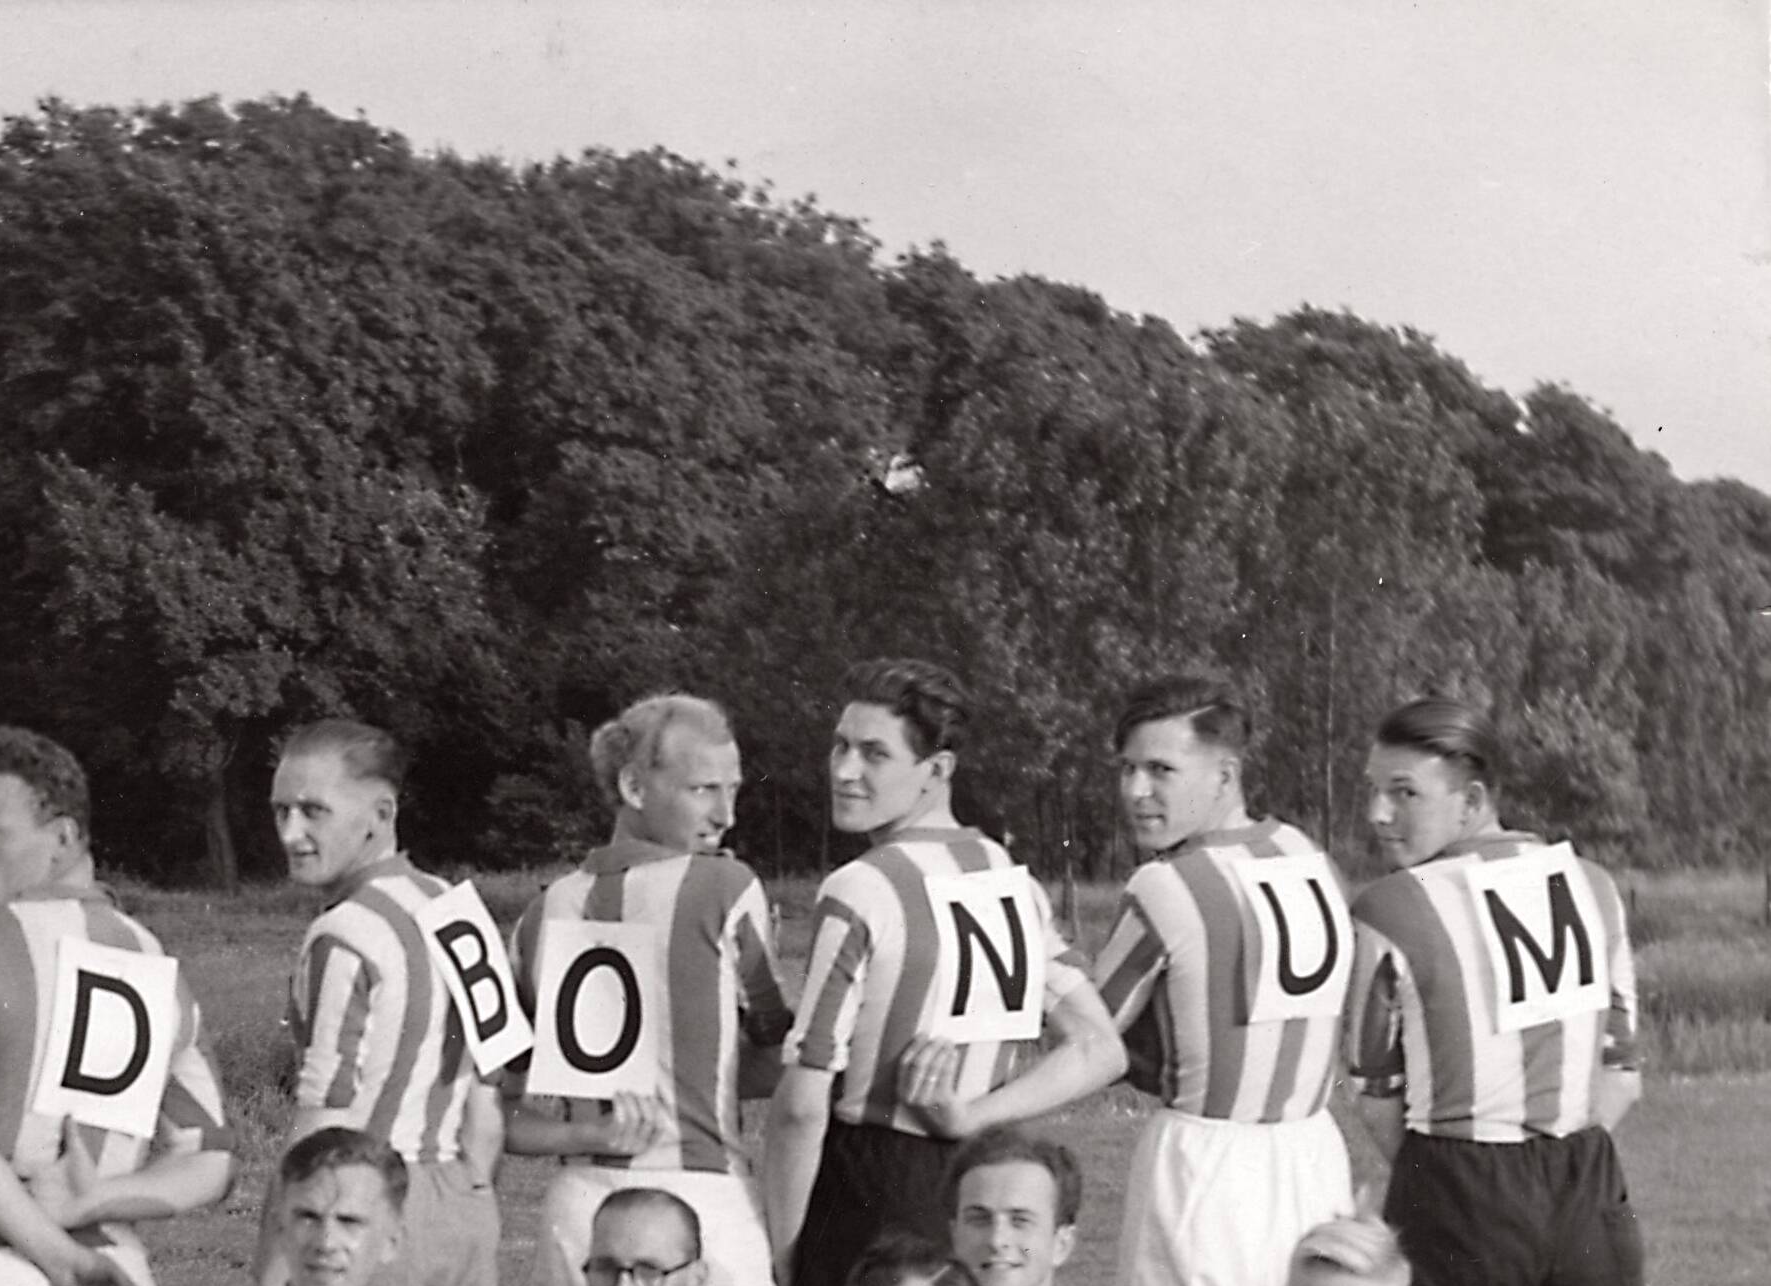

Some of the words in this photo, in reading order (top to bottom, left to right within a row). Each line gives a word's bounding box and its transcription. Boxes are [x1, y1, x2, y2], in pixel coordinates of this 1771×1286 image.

[435, 921, 507, 1041] B
[950, 897, 1026, 1016] N
[1260, 880, 1337, 995] U
[1485, 873, 1592, 1003] M
[61, 970, 150, 1095] D
[556, 947, 641, 1073] O
